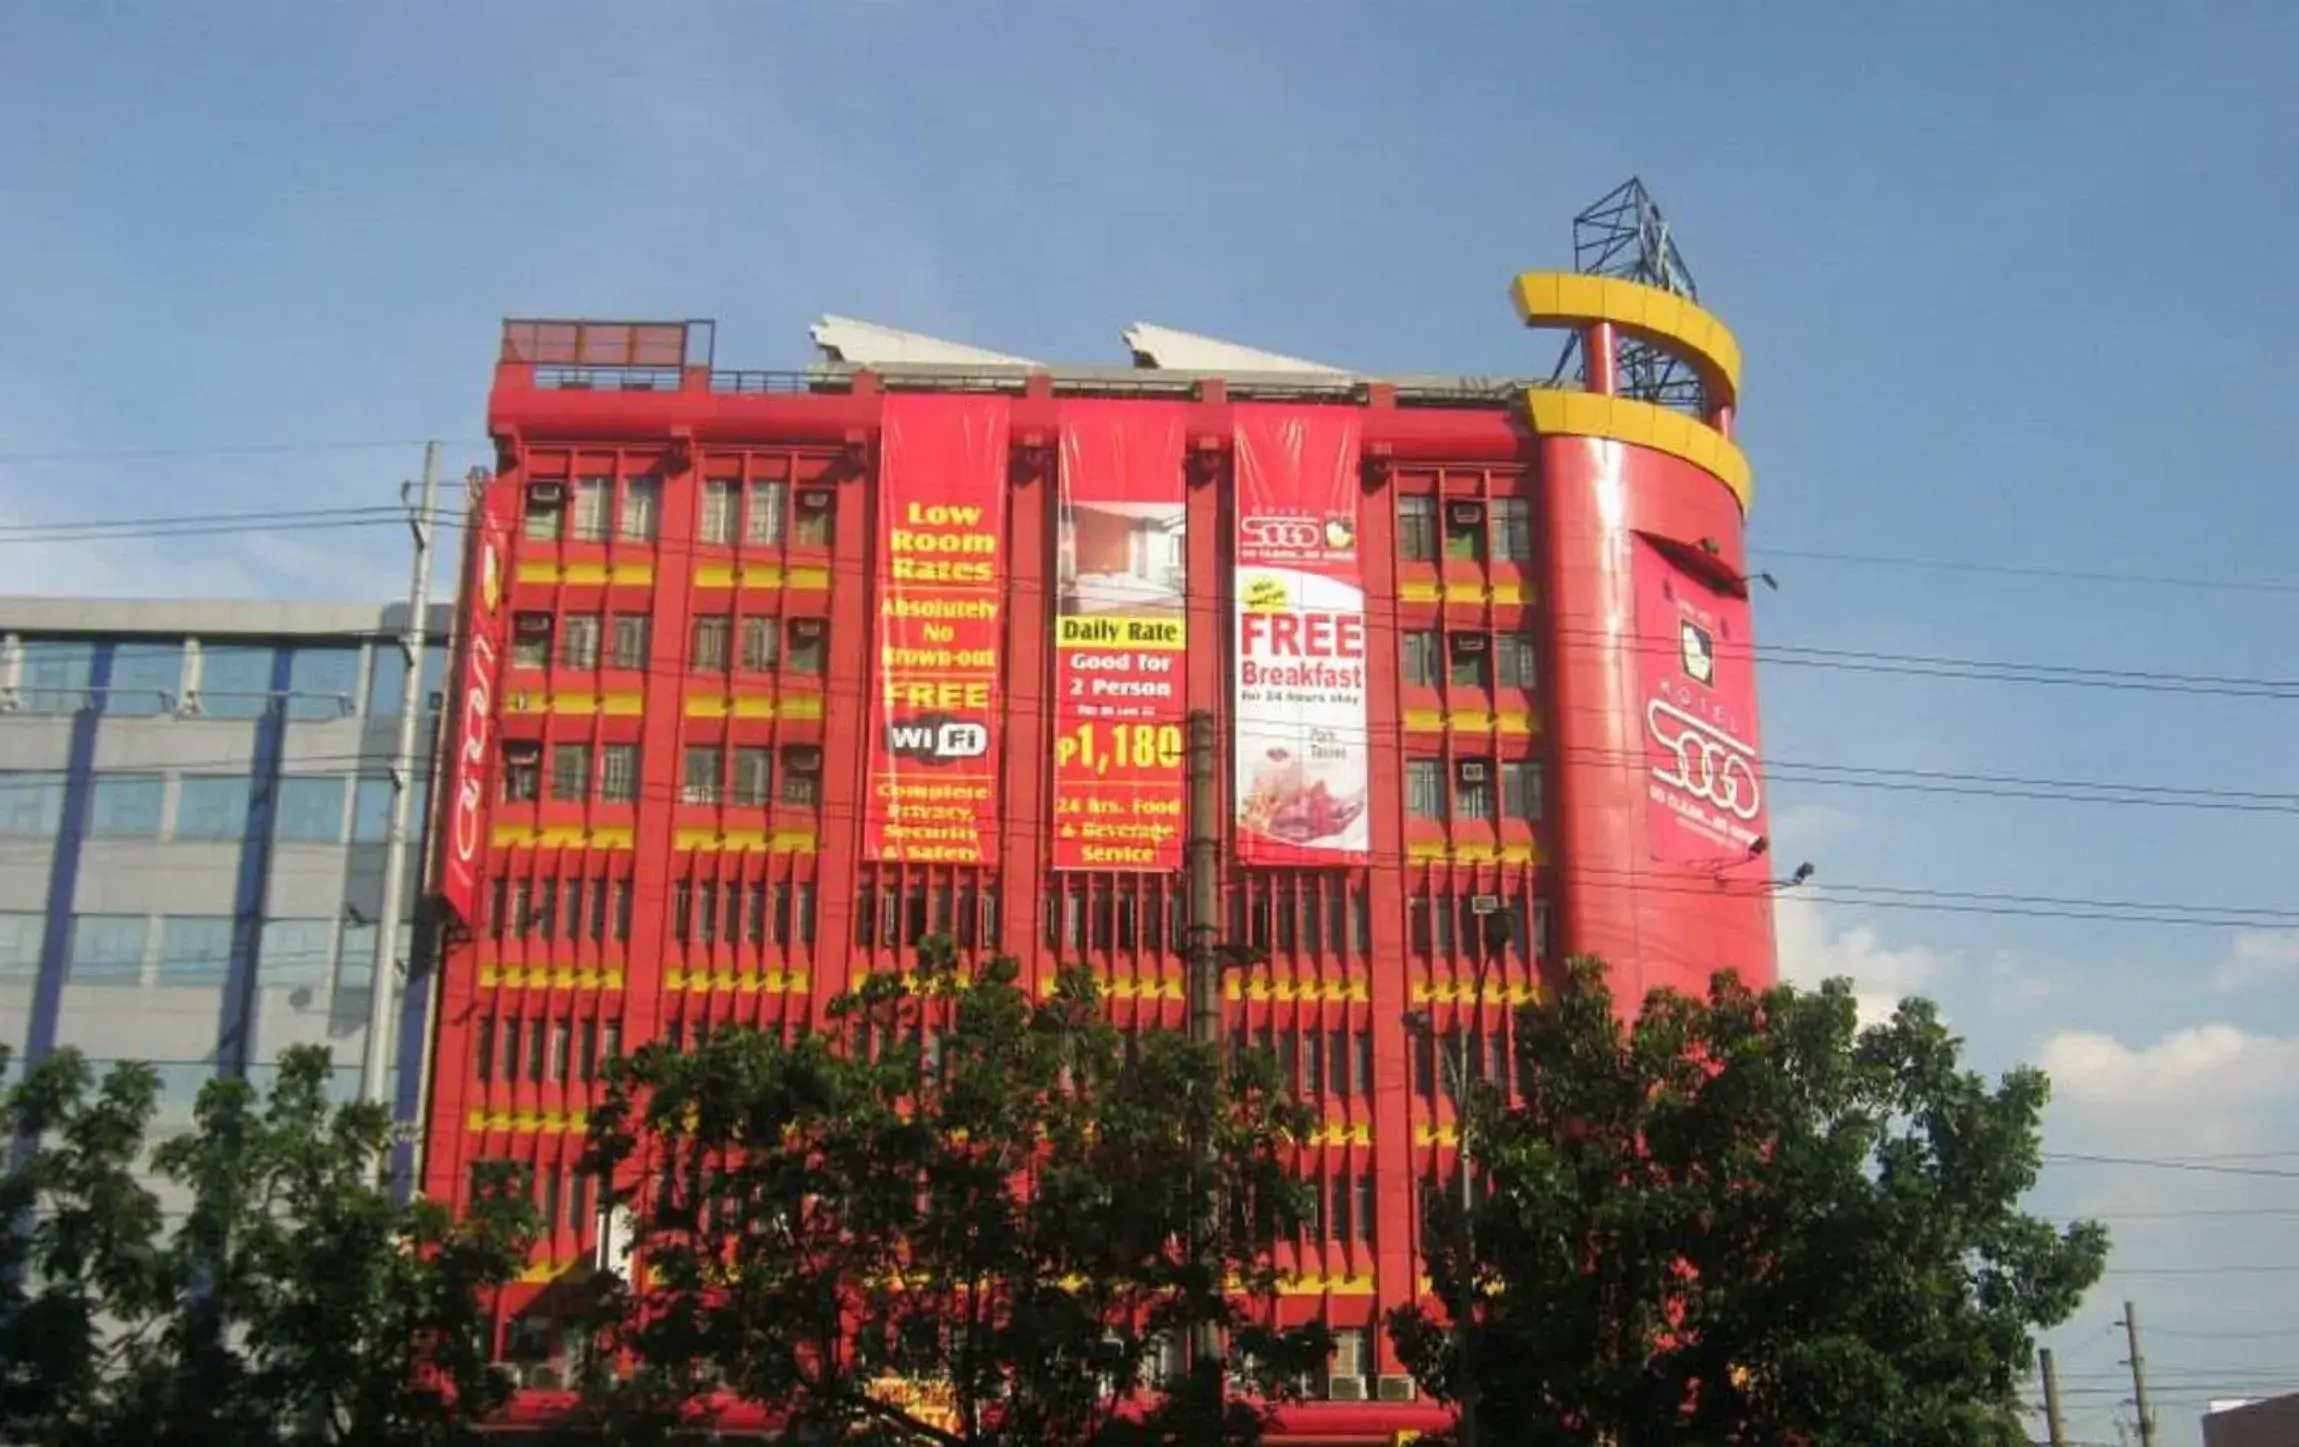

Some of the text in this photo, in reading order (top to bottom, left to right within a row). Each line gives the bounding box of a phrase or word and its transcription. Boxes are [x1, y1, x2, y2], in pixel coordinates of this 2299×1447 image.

[907, 502, 982, 526] Low
[890, 529, 996, 554] Room
[892, 558, 994, 581] Rates
[881, 598, 998, 619] Absolutely
[922, 622, 955, 642] No
[1063, 619, 1177, 643] Daily Rate
[1241, 613, 1362, 658] FREE
[1070, 653, 1171, 672] Good for
[1241, 661, 1361, 689] Breakfast
[882, 682, 991, 709] FREE
[1070, 678, 1171, 697] 2 Person
